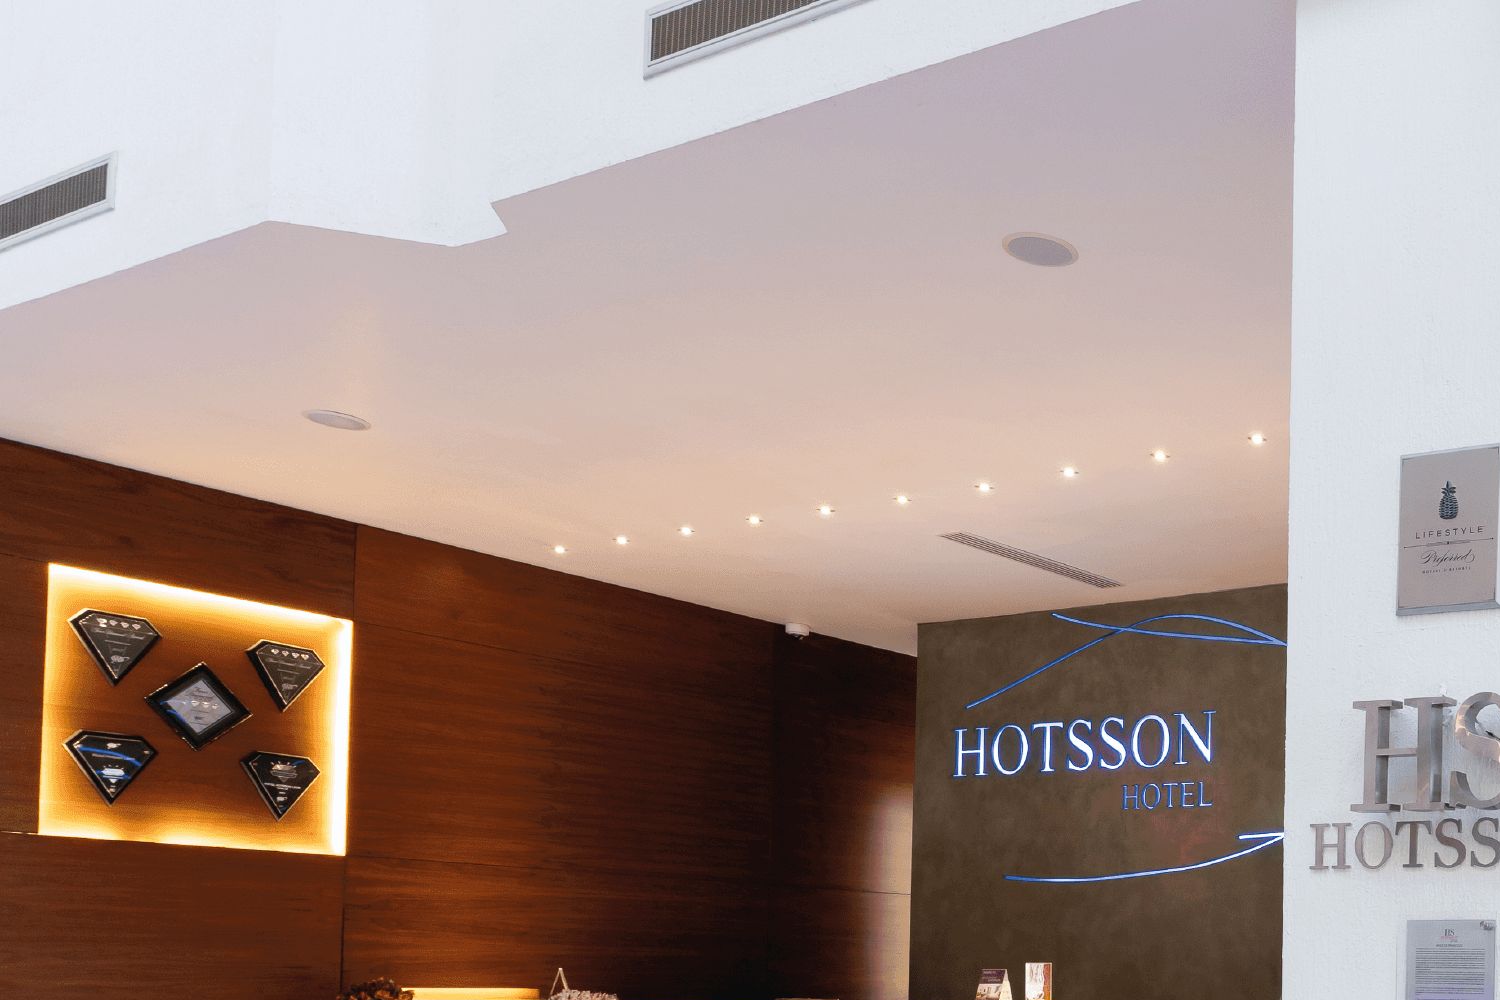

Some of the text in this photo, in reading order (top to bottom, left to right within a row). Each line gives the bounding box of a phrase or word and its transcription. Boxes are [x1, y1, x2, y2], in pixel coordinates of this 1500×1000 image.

[1415, 526, 1484, 540] LIFESTYLE
[1420, 549, 1476, 567] Preferred
[953, 710, 1217, 778] HOTSSON
[1122, 781, 1213, 811] HOTEL
